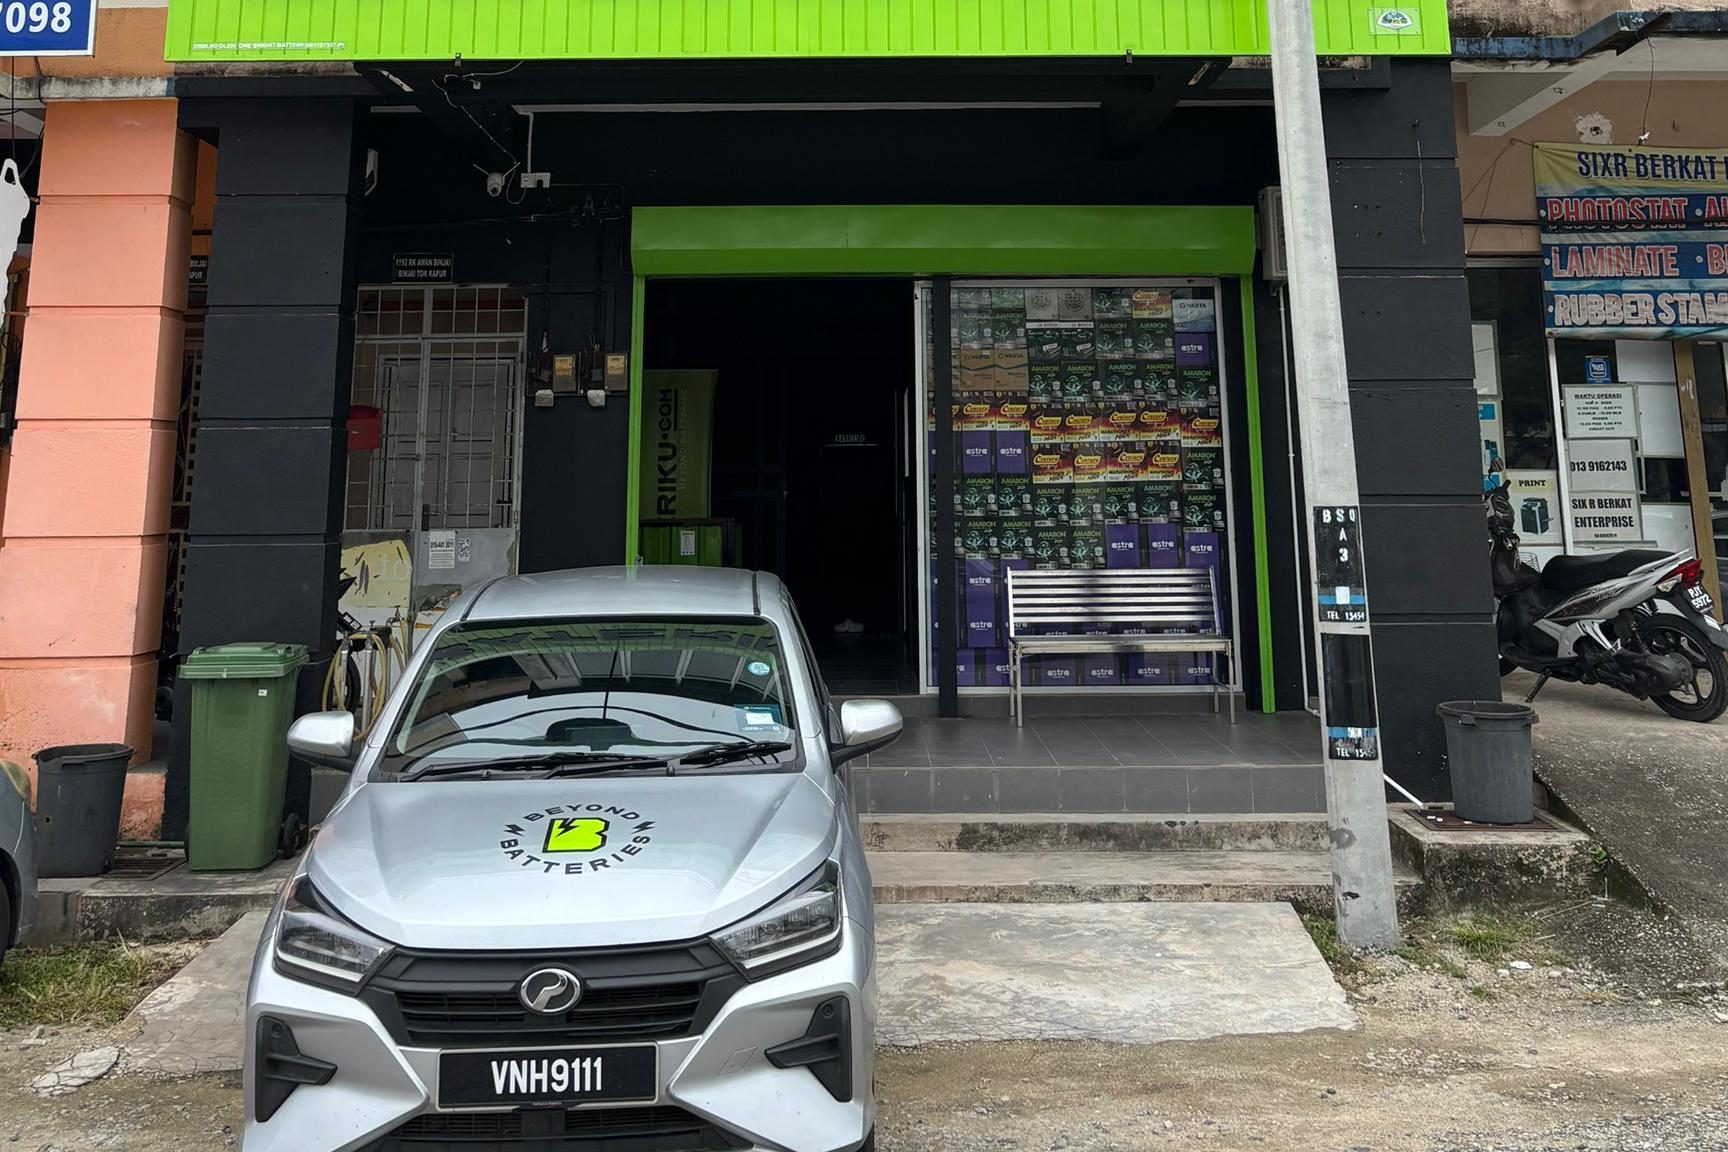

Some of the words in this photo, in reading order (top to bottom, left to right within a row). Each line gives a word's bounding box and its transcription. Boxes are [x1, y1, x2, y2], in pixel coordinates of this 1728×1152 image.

[0, 1, 72, 34] 098
[1633, 153, 1717, 182] BERKAT
[1546, 197, 1688, 230] PHOTOSTAT
[1551, 245, 1680, 278] LAMINATE
[1588, 460, 1628, 472] 9162143
[1518, 479, 1547, 487] PRINT
[1572, 499, 1588, 510] SIX
[1589, 499, 1596, 509] R
[1597, 498, 1632, 509] BERKAT
[1574, 516, 1635, 528] ENTERPRISE
[1339, 527, 1348, 541] A
[1111, 541, 1134, 549] astra
[1190, 544, 1213, 552] astra
[1338, 547, 1349, 562] 3
[1326, 611, 1339, 620] TEL
[1336, 747, 1350, 757] TEL
[523, 804, 640, 822] BEYOND
[500, 835, 651, 875] BATTERIES
[491, 1056, 603, 1095] VNH9111
